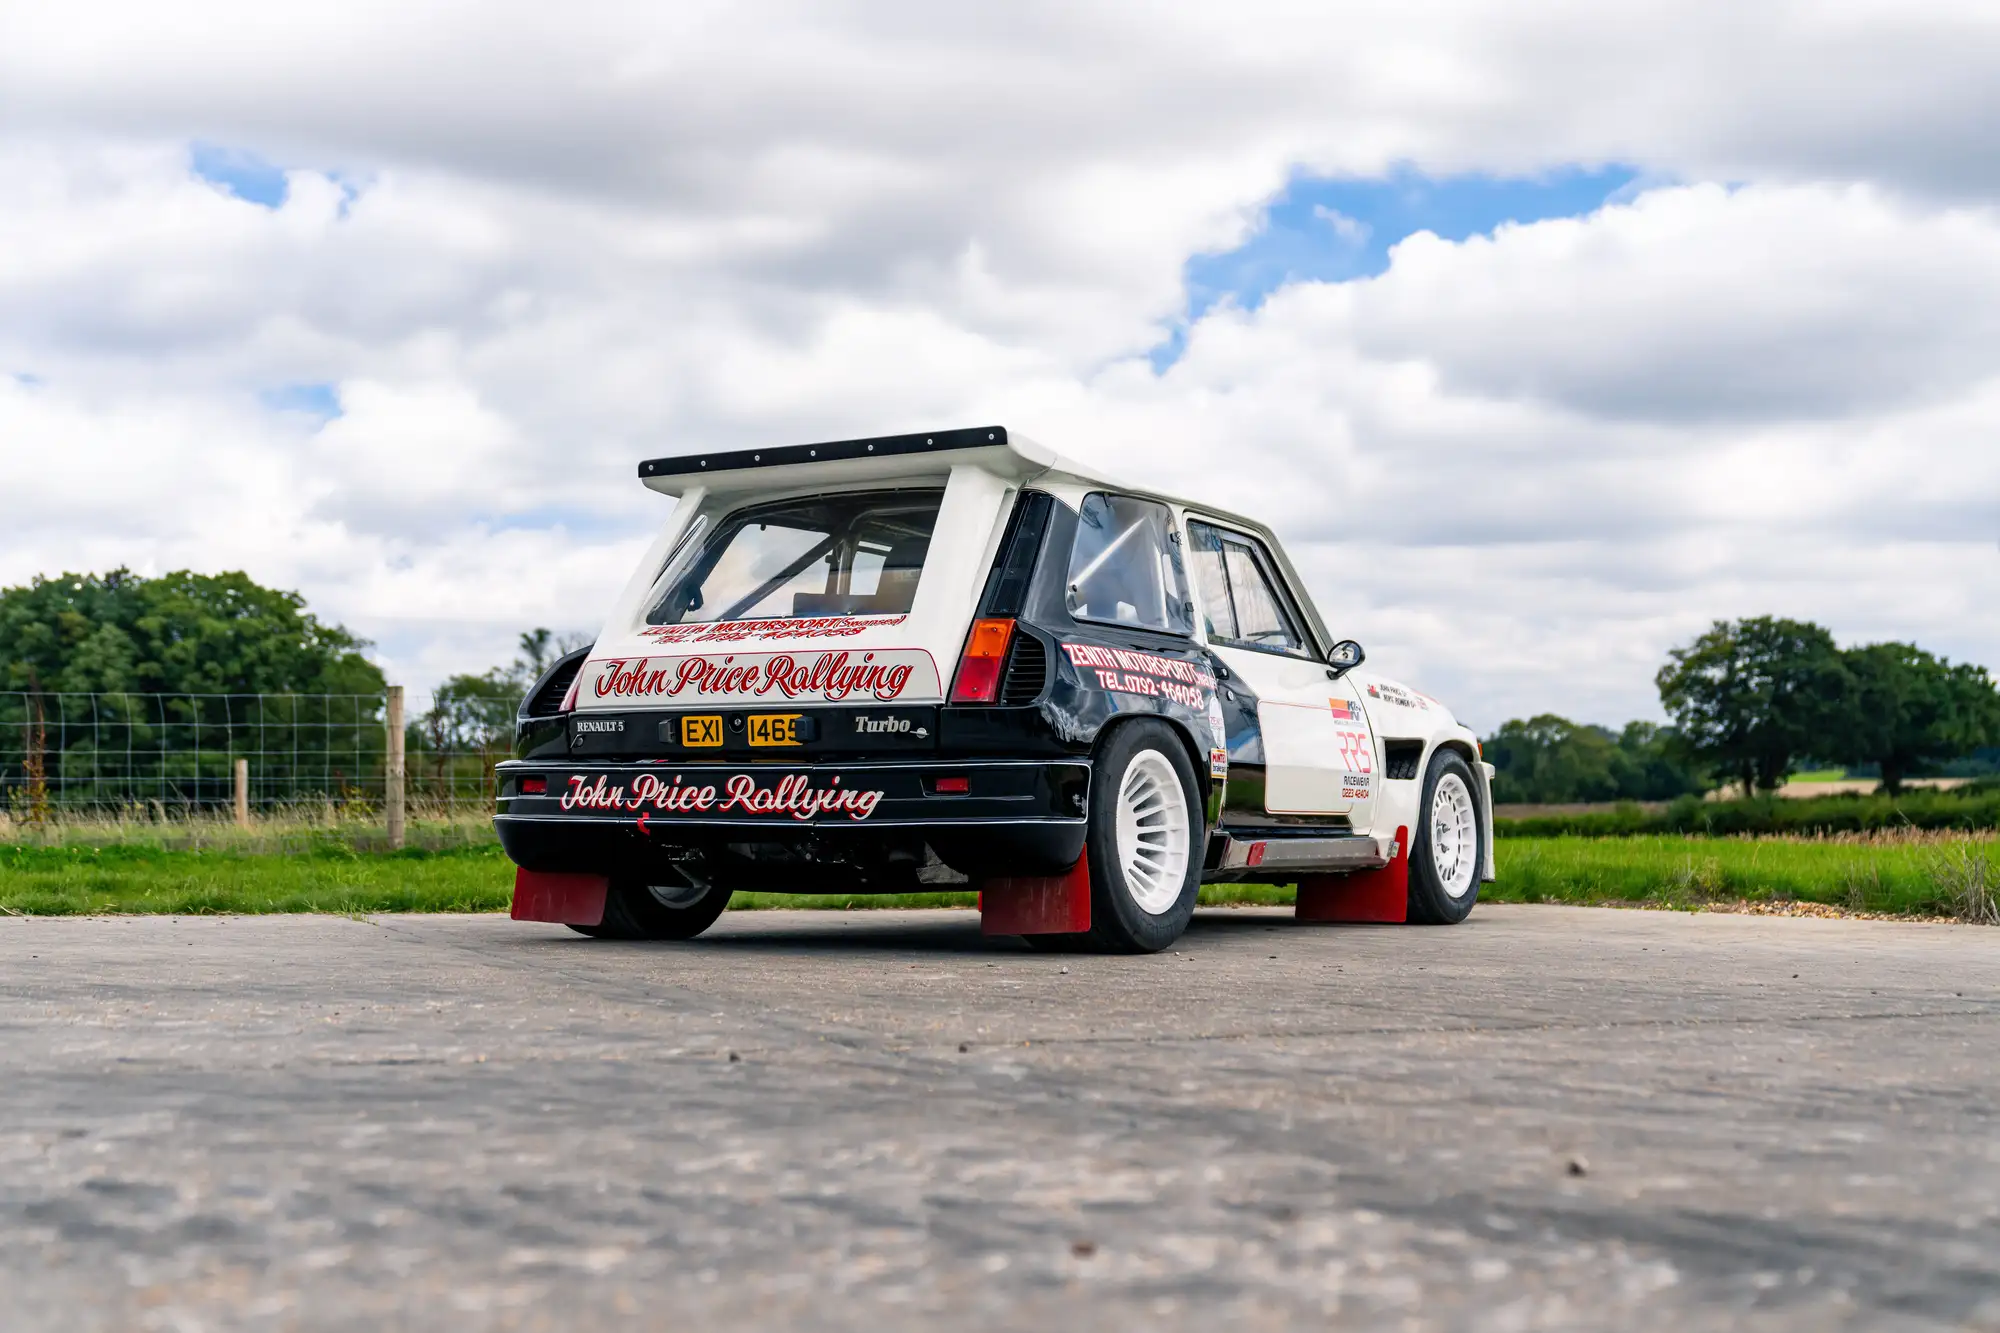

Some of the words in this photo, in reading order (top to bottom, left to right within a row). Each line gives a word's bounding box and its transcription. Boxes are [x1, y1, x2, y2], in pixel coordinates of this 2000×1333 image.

[638, 624, 711, 636] ZENITH
[1061, 643, 1120, 668] ZENITH
[596, 659, 671, 698] John
[668, 655, 760, 698] Price
[756, 652, 914, 701] Rallying
[577, 721, 616, 732] RENAULT
[618, 721, 624, 732] 5
[686, 719, 720, 742] EXI
[855, 716, 911, 733] Turbo
[1344, 775, 1370, 786] RACEWEAR
[560, 774, 625, 811] John
[622, 774, 718, 812] Price
[719, 774, 885, 820] Rallying
[1342, 787, 1354, 798] 0223
